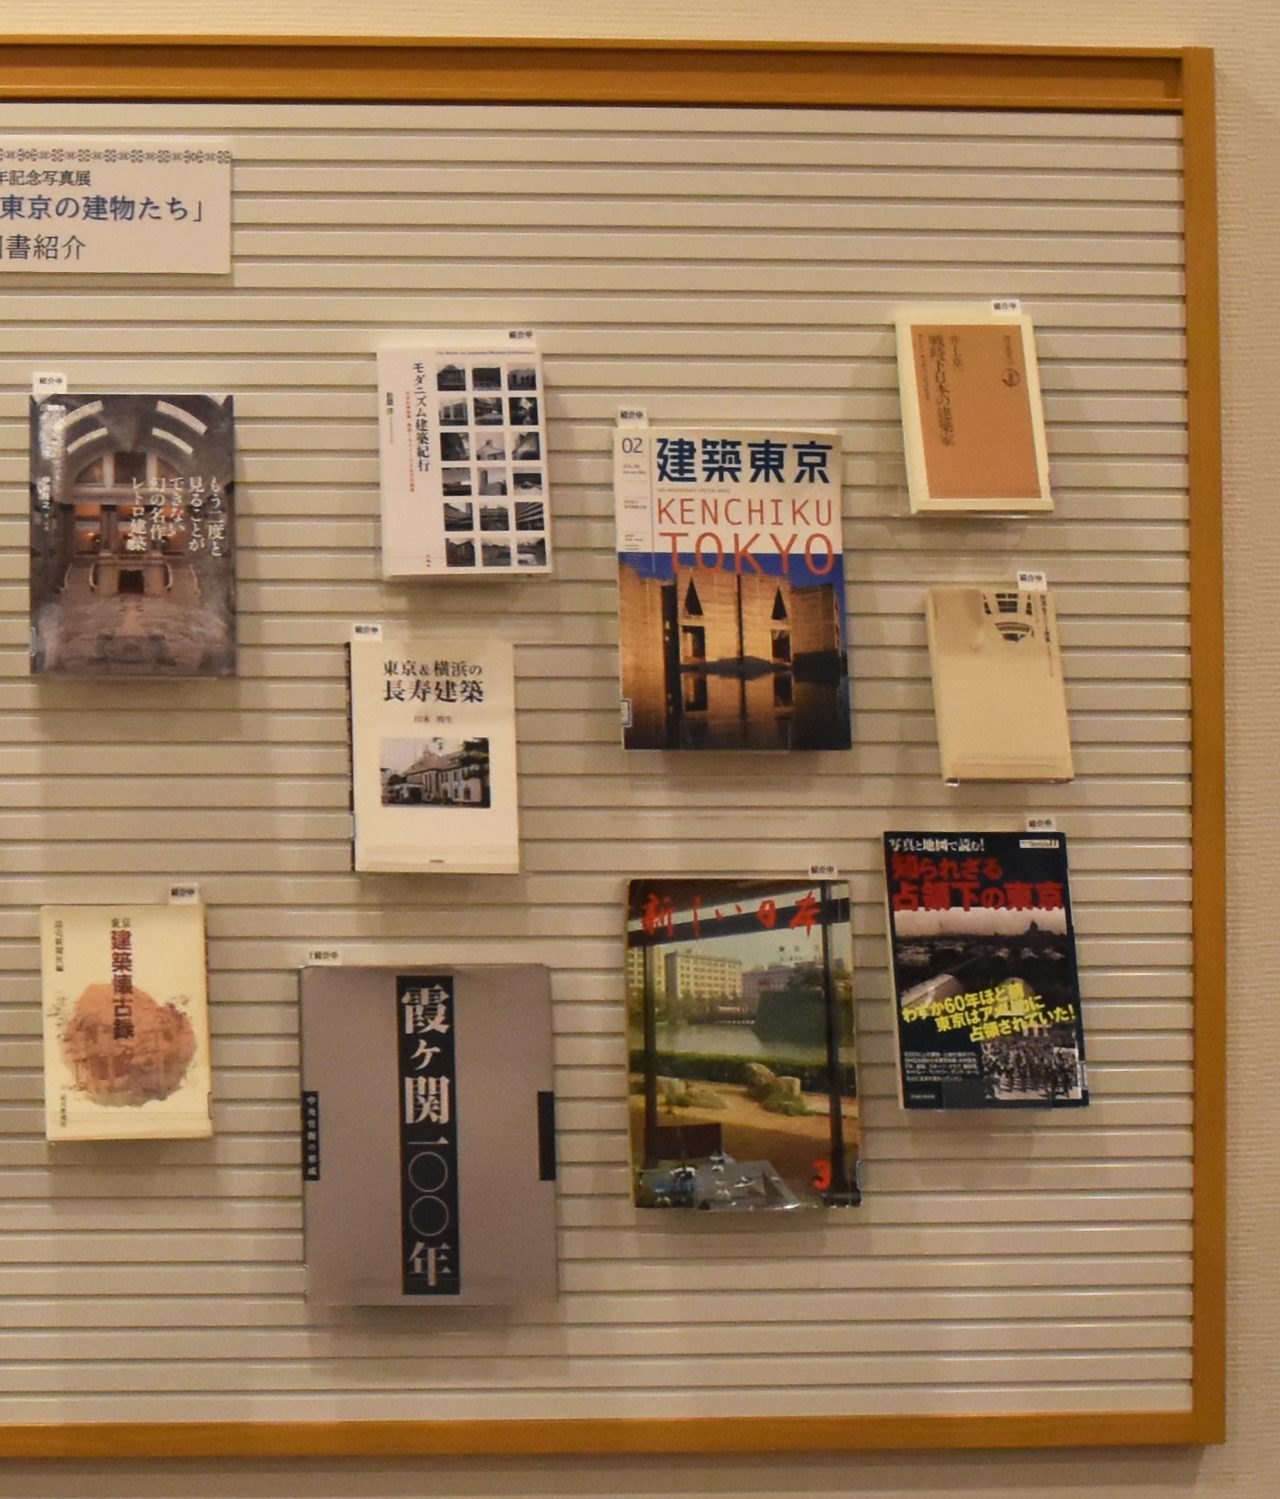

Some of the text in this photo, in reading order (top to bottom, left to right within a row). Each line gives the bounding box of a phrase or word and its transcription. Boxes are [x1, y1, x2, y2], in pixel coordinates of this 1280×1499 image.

[0, 194, 205, 223] 東京の建物たち」
[412, 362, 430, 473] モダニズム建築紀行
[621, 437, 644, 455] 02
[655, 437, 834, 485] 建築東京
[188, 476, 206, 552] 見ることが
[656, 497, 834, 527] KENCHIKU
[658, 531, 837, 576] TOKYO
[382, 680, 485, 703] 長寿建築
[891, 854, 1003, 881] 知られざる
[892, 881, 1064, 912] 占領下の東京
[639, 889, 822, 939] 新しい日本
[811, 1158, 832, 1191] 3
